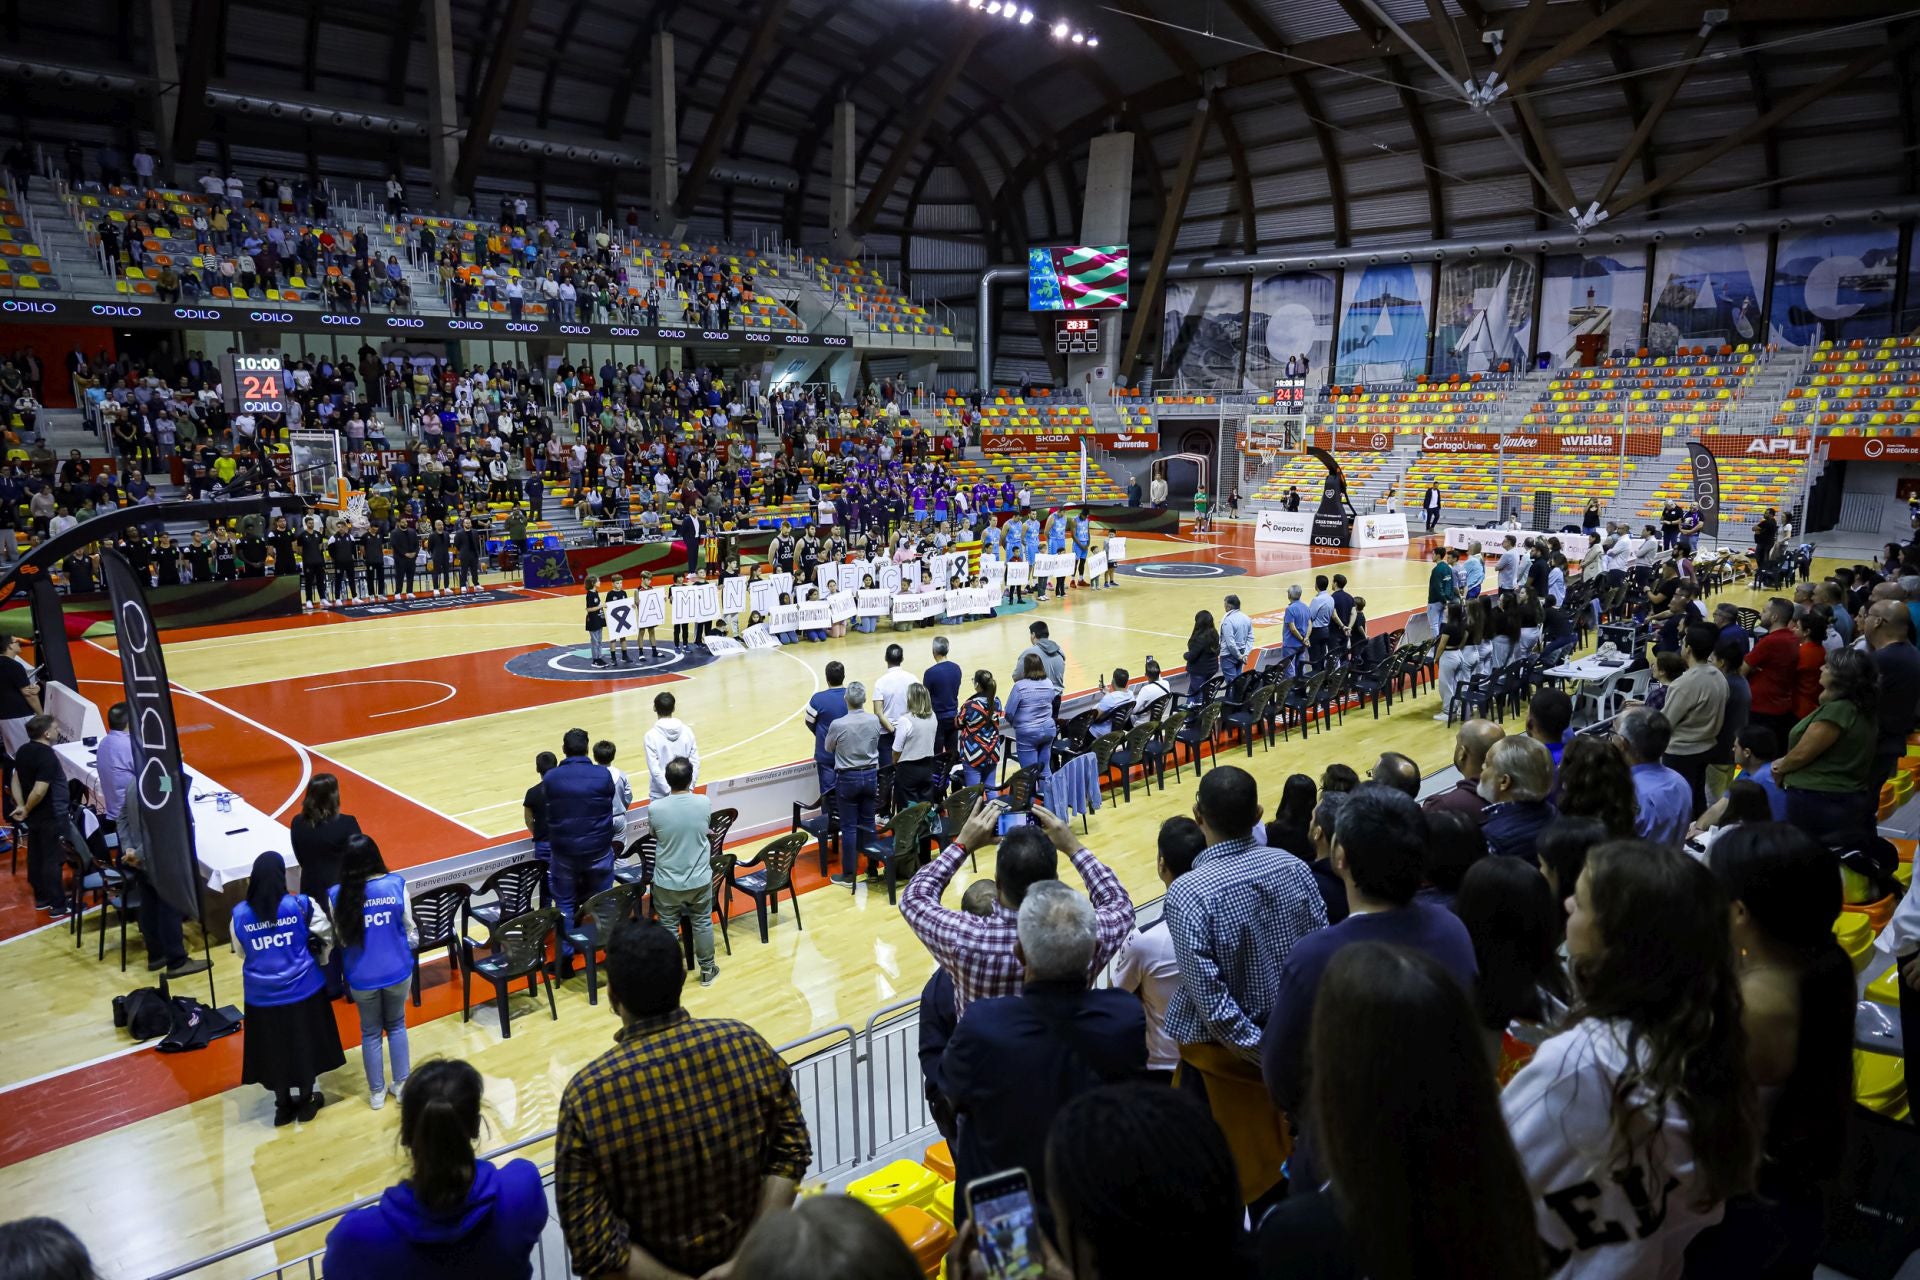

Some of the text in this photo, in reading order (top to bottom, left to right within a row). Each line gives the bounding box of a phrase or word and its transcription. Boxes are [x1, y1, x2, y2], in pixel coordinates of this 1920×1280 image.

[2, 300, 57, 313] ODILO
[92, 305, 142, 317] ODILO
[174, 308, 221, 320] ODILO
[250, 311, 293, 323] ODILO
[321, 315, 361, 325] ODILO
[387, 317, 425, 328] ODILO
[448, 320, 484, 330] ODILO
[506, 322, 539, 333] ODILO
[560, 325, 591, 335] ODILO
[610, 327, 640, 337] ODILO
[658, 330, 685, 339] ODILO
[703, 332, 729, 341] ODILO
[238, 357, 280, 370] 10:00
[243, 376, 279, 399] 24
[1277, 389, 1291, 400] 24
[1294, 388, 1303, 400] 24
[244, 401, 283, 412] ODILO
[1696, 454, 1714, 510] ODILO
[1272, 525, 1304, 533] Deportes
[1314, 537, 1341, 546] ODILO
[122, 600, 172, 810] ODILO
[415, 872, 461, 889] Bienvenidos
[468, 866, 483, 875] este
[485, 859, 511, 871] espacio
[512, 854, 525, 863] VIP
[364, 896, 396, 907] NTARIADO
[365, 911, 392, 928] PCT
[251, 931, 294, 951] UPCT
